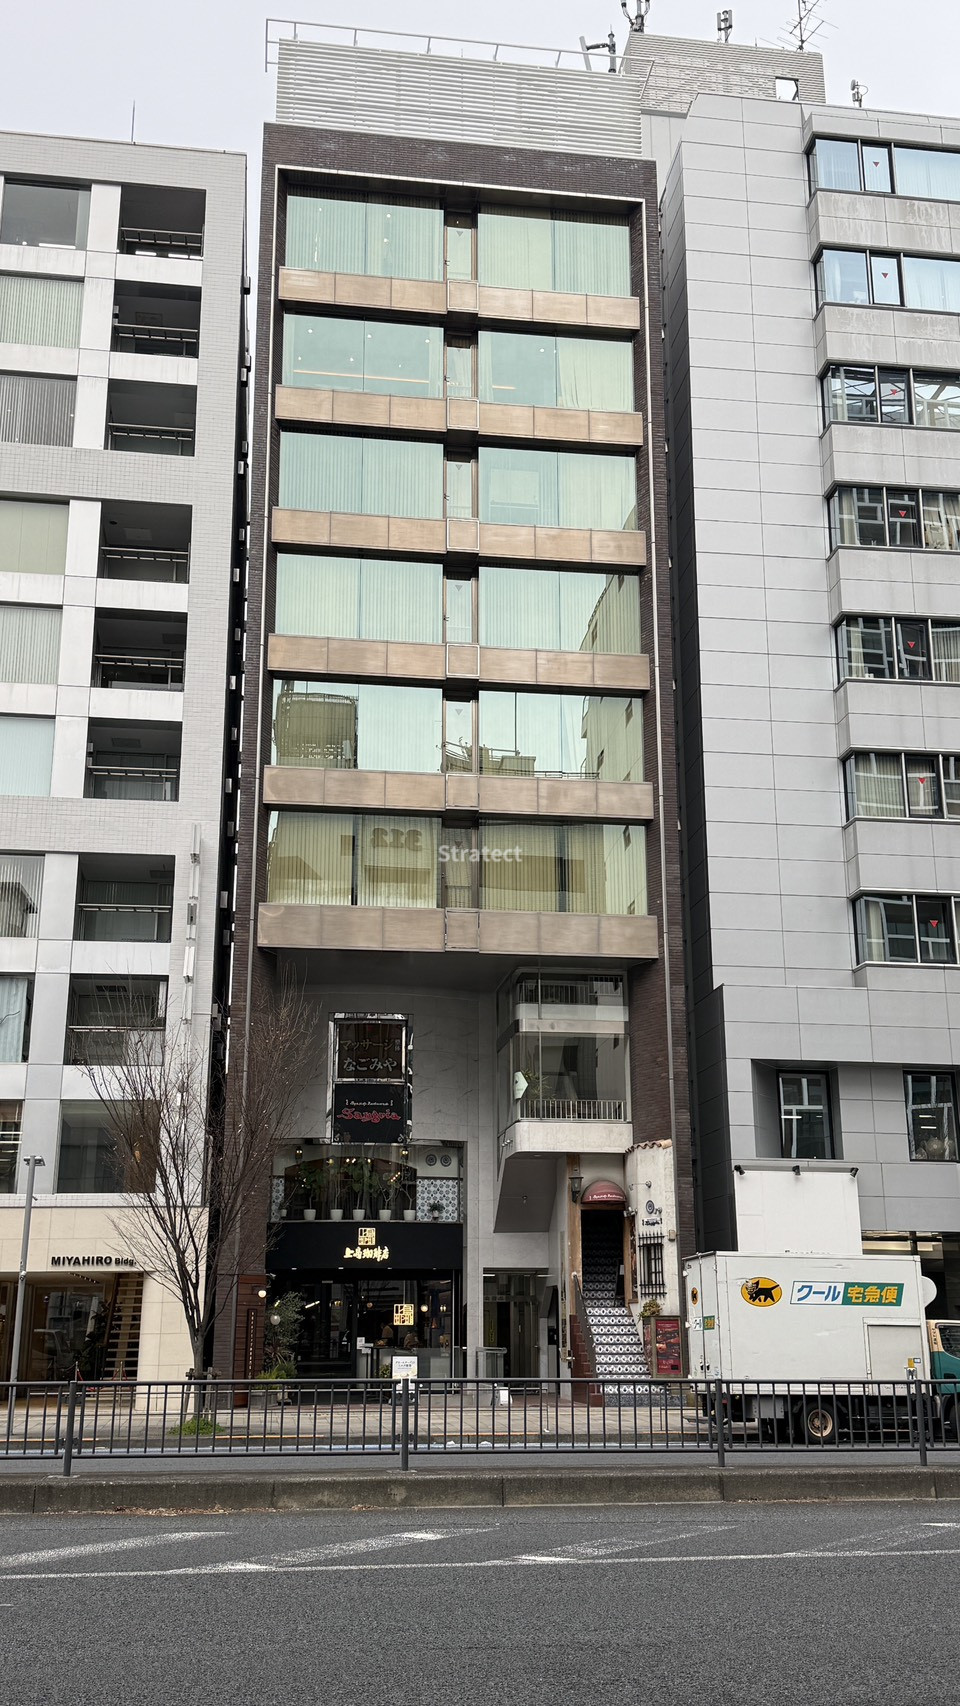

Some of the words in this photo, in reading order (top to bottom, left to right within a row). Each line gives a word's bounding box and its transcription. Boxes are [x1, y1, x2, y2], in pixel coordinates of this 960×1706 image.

[340, 1038, 394, 1051] マッサージ
[343, 1057, 397, 1072] なごみや
[51, 1256, 113, 1266] MIYAHIRO
[114, 1257, 137, 1267] Bldg.
